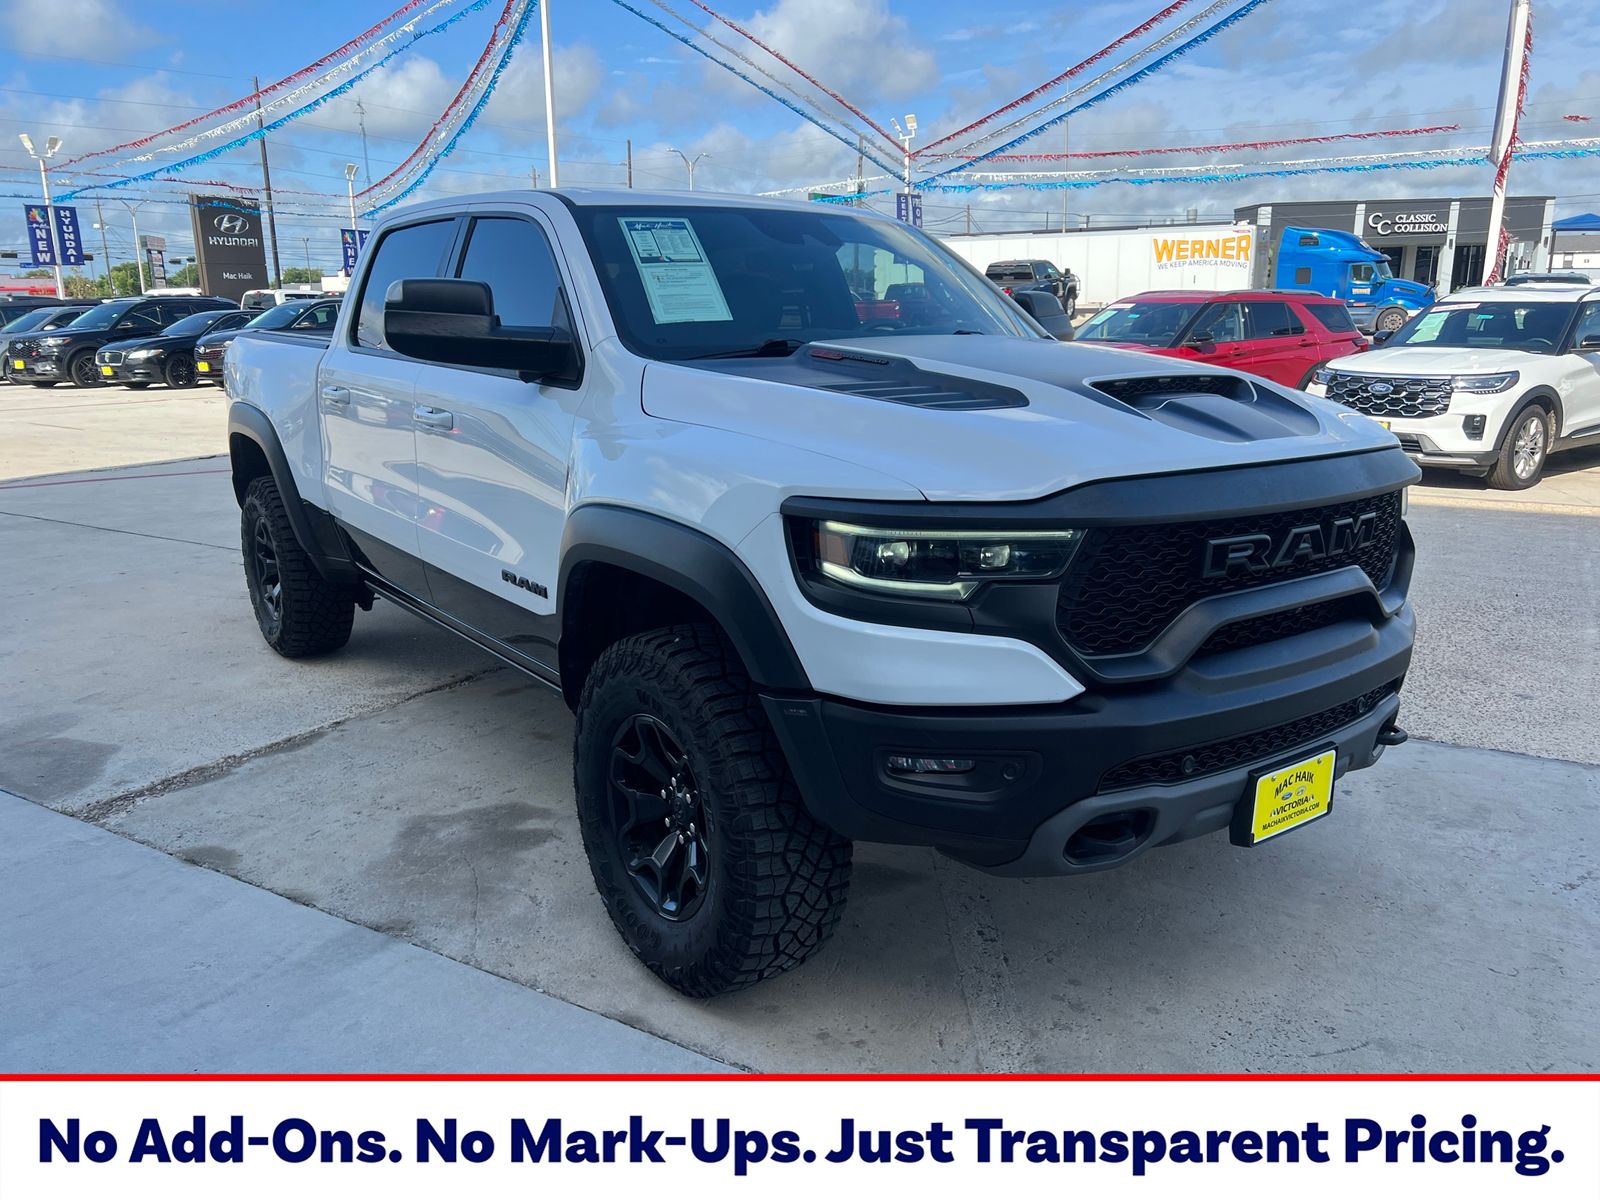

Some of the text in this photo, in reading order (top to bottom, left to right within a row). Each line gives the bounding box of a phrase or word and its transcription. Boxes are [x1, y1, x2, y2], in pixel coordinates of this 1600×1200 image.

[1394, 223, 1448, 233] COLLISION
[1395, 214, 1436, 223] CLASSIC
[35, 229, 51, 263] NEW
[60, 210, 77, 263] HYUNDAI
[208, 236, 259, 247] HYUNDAI
[1153, 235, 1251, 263] WERNER
[222, 272, 253, 280] Mac Haik
[1219, 260, 1248, 269] MOVING
[1203, 512, 1377, 578] RAM
[501, 568, 548, 600] RAM
[1274, 774, 1294, 799] MAC
[1295, 771, 1315, 784] HAIK
[1262, 802, 1320, 831] MACHAIKVICTORIA.COM
[1275, 795, 1309, 817] VICTORIA
